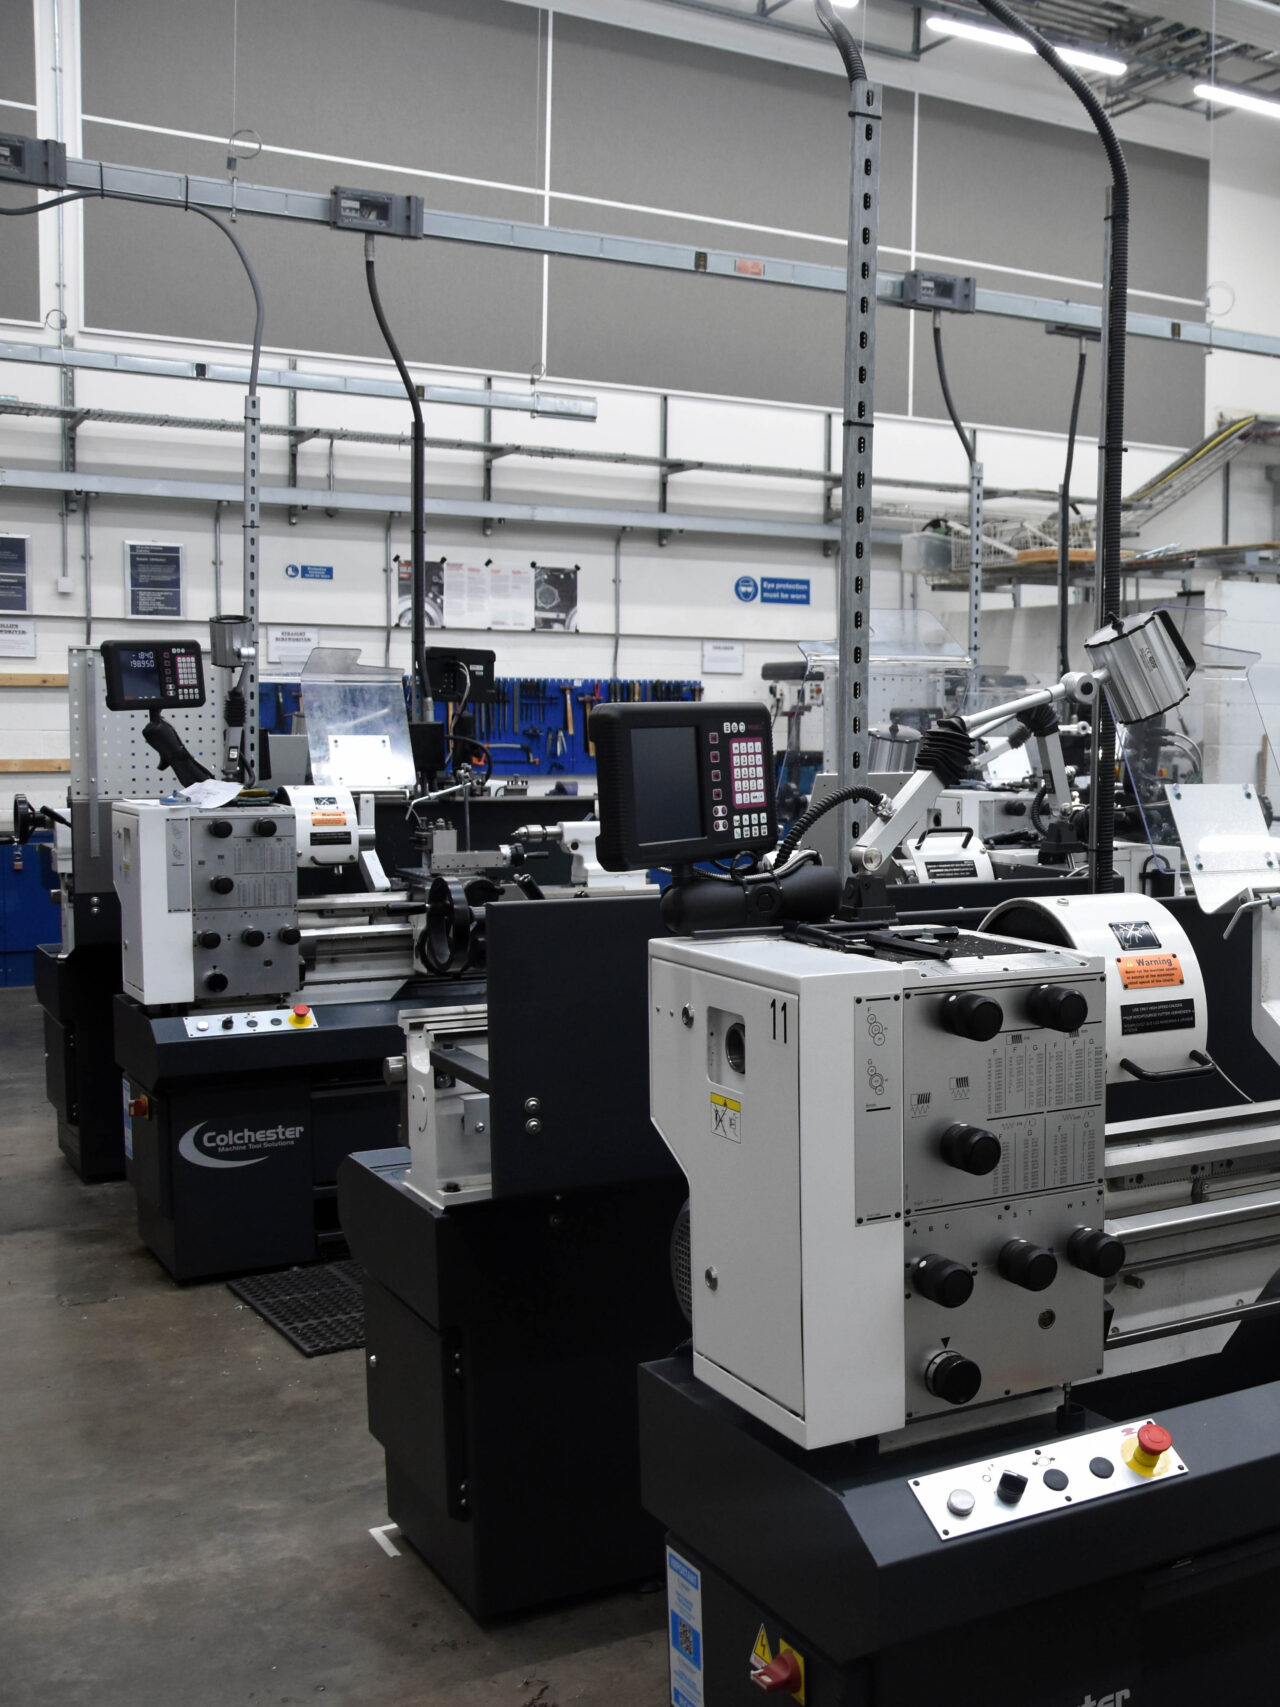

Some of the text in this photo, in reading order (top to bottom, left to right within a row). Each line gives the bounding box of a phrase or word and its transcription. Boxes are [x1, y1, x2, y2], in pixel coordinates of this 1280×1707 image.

[763, 581, 774, 589] Eye
[1136, 958, 1172, 966] Warning
[770, 998, 787, 1044] 11
[203, 1124, 304, 1147] Colchester
